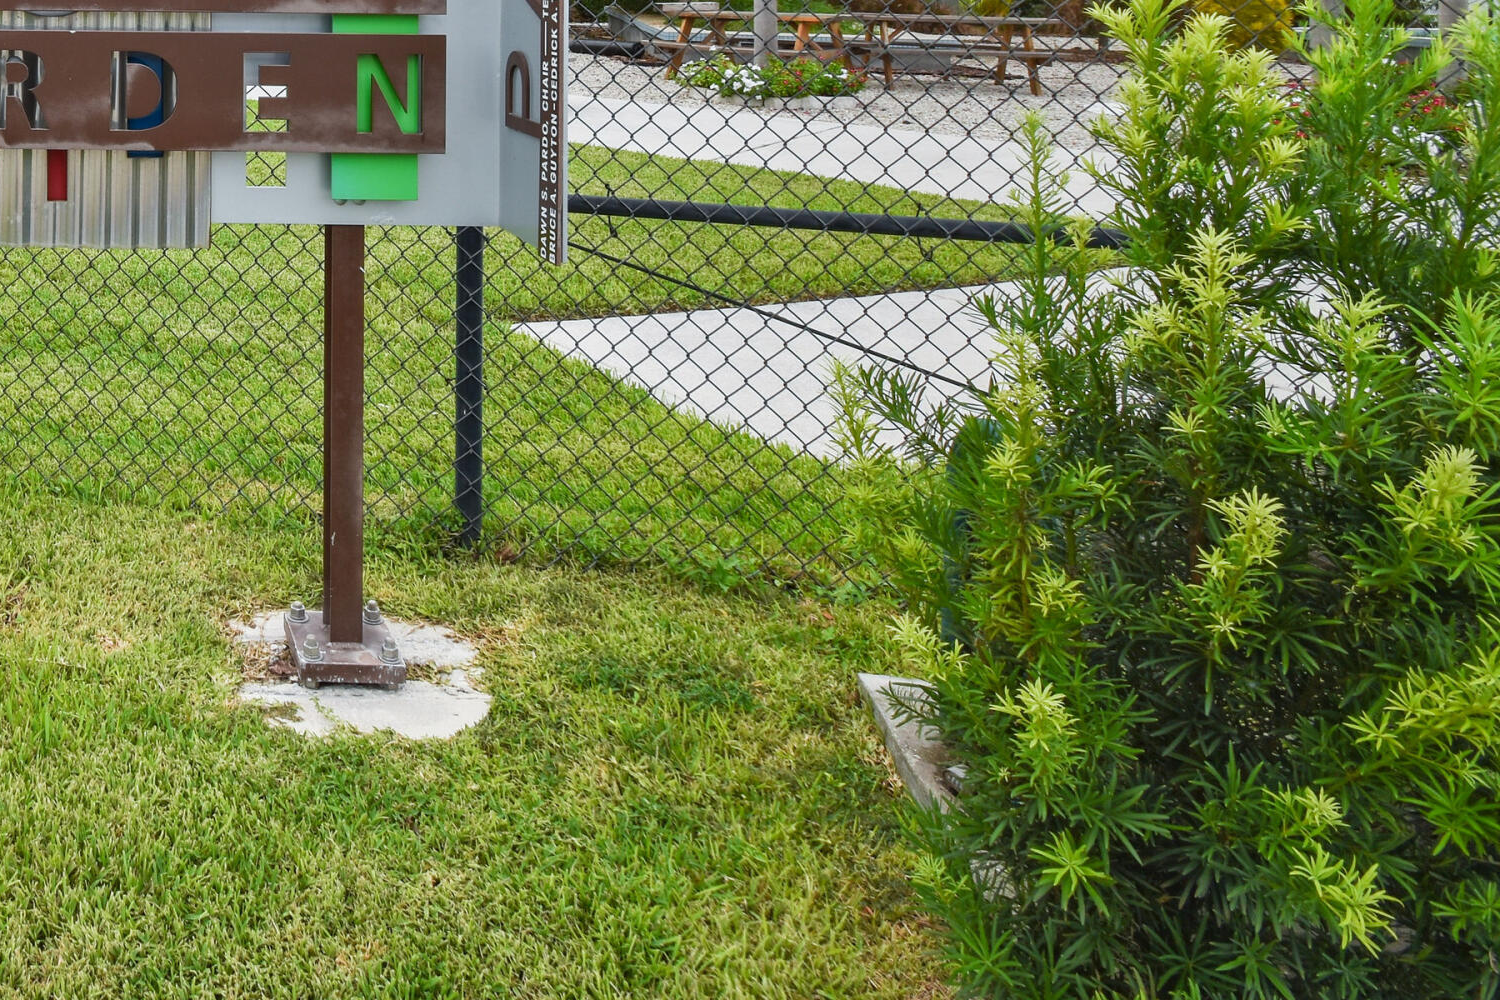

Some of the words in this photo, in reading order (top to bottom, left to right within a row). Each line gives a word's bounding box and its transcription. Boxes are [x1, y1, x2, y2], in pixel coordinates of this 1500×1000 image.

[551, 7, 558, 23] A.
[541, 186, 548, 201] S.
[550, 188, 557, 205] A.
[540, 206, 548, 259] DAWN
